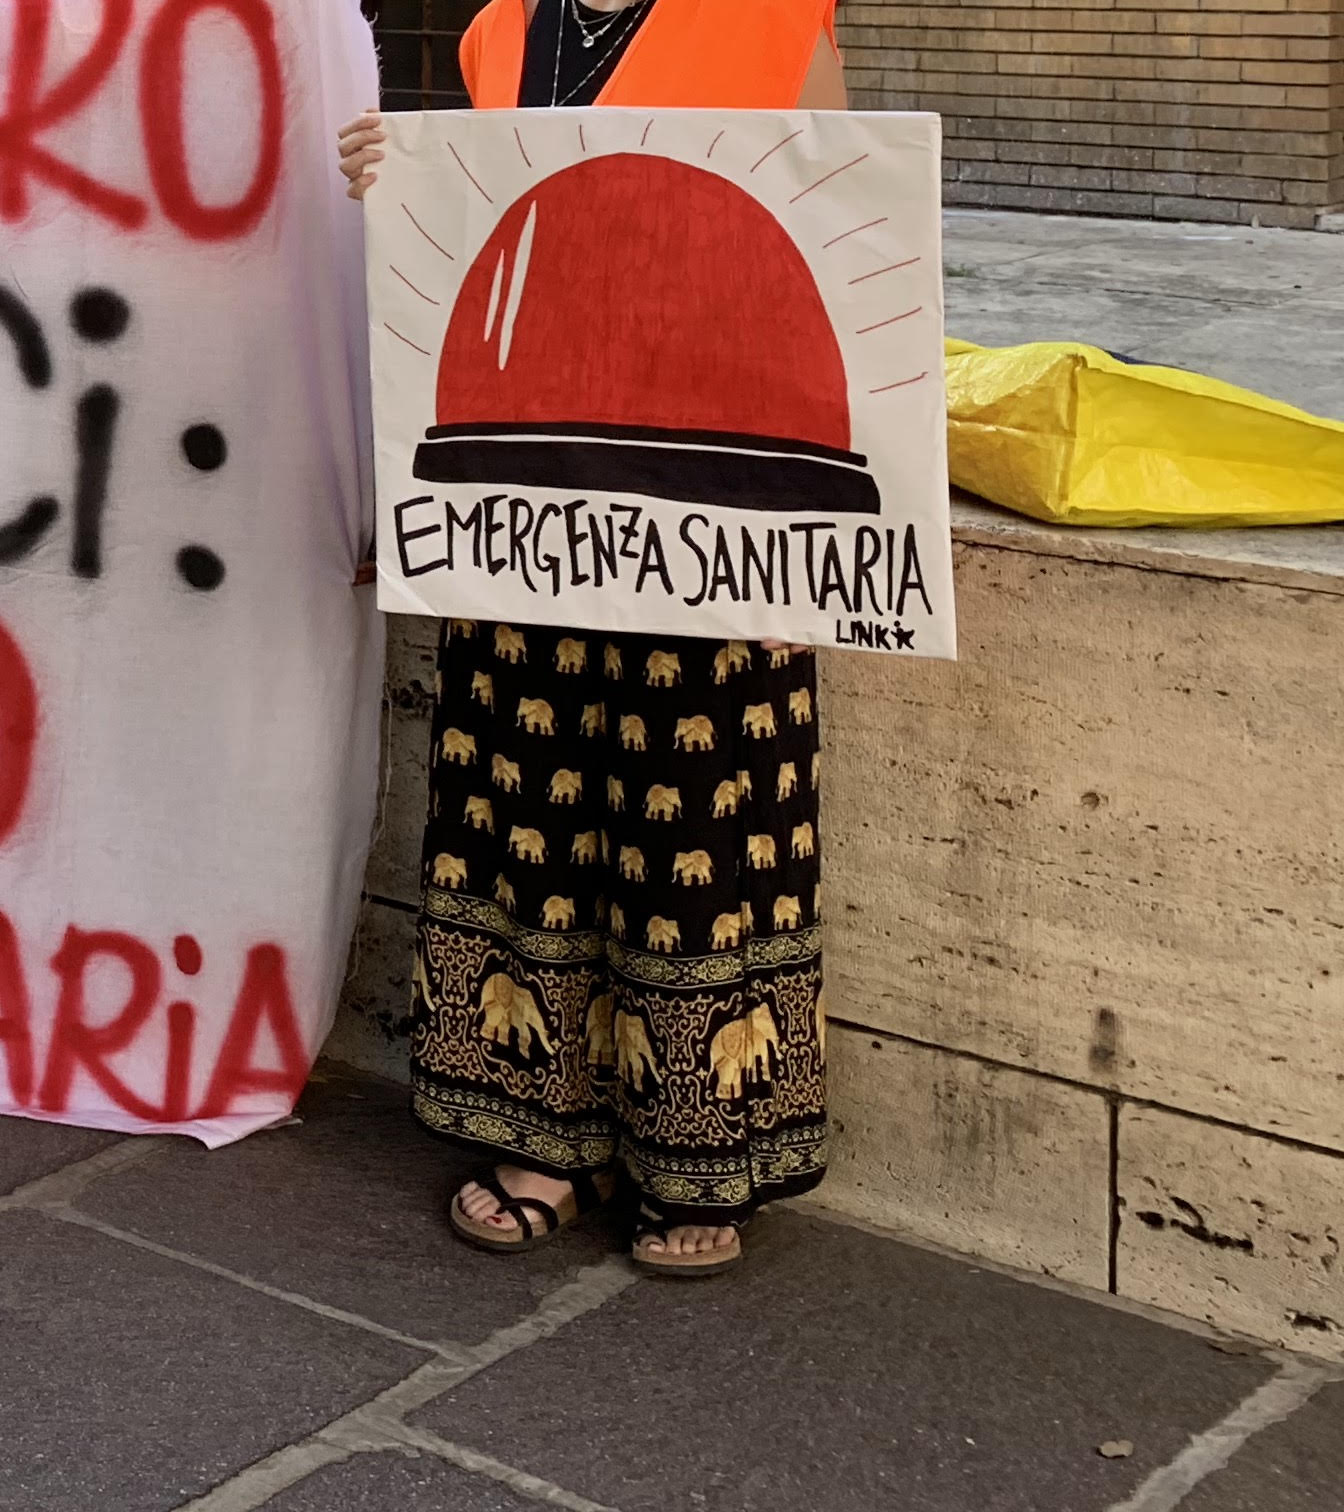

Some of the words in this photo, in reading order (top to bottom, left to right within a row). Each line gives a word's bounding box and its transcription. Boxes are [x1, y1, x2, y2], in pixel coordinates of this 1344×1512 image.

[394, 494, 674, 597] EMERGENZA
[678, 513, 934, 617] SANITARIA
[835, 619, 892, 651] LINK
